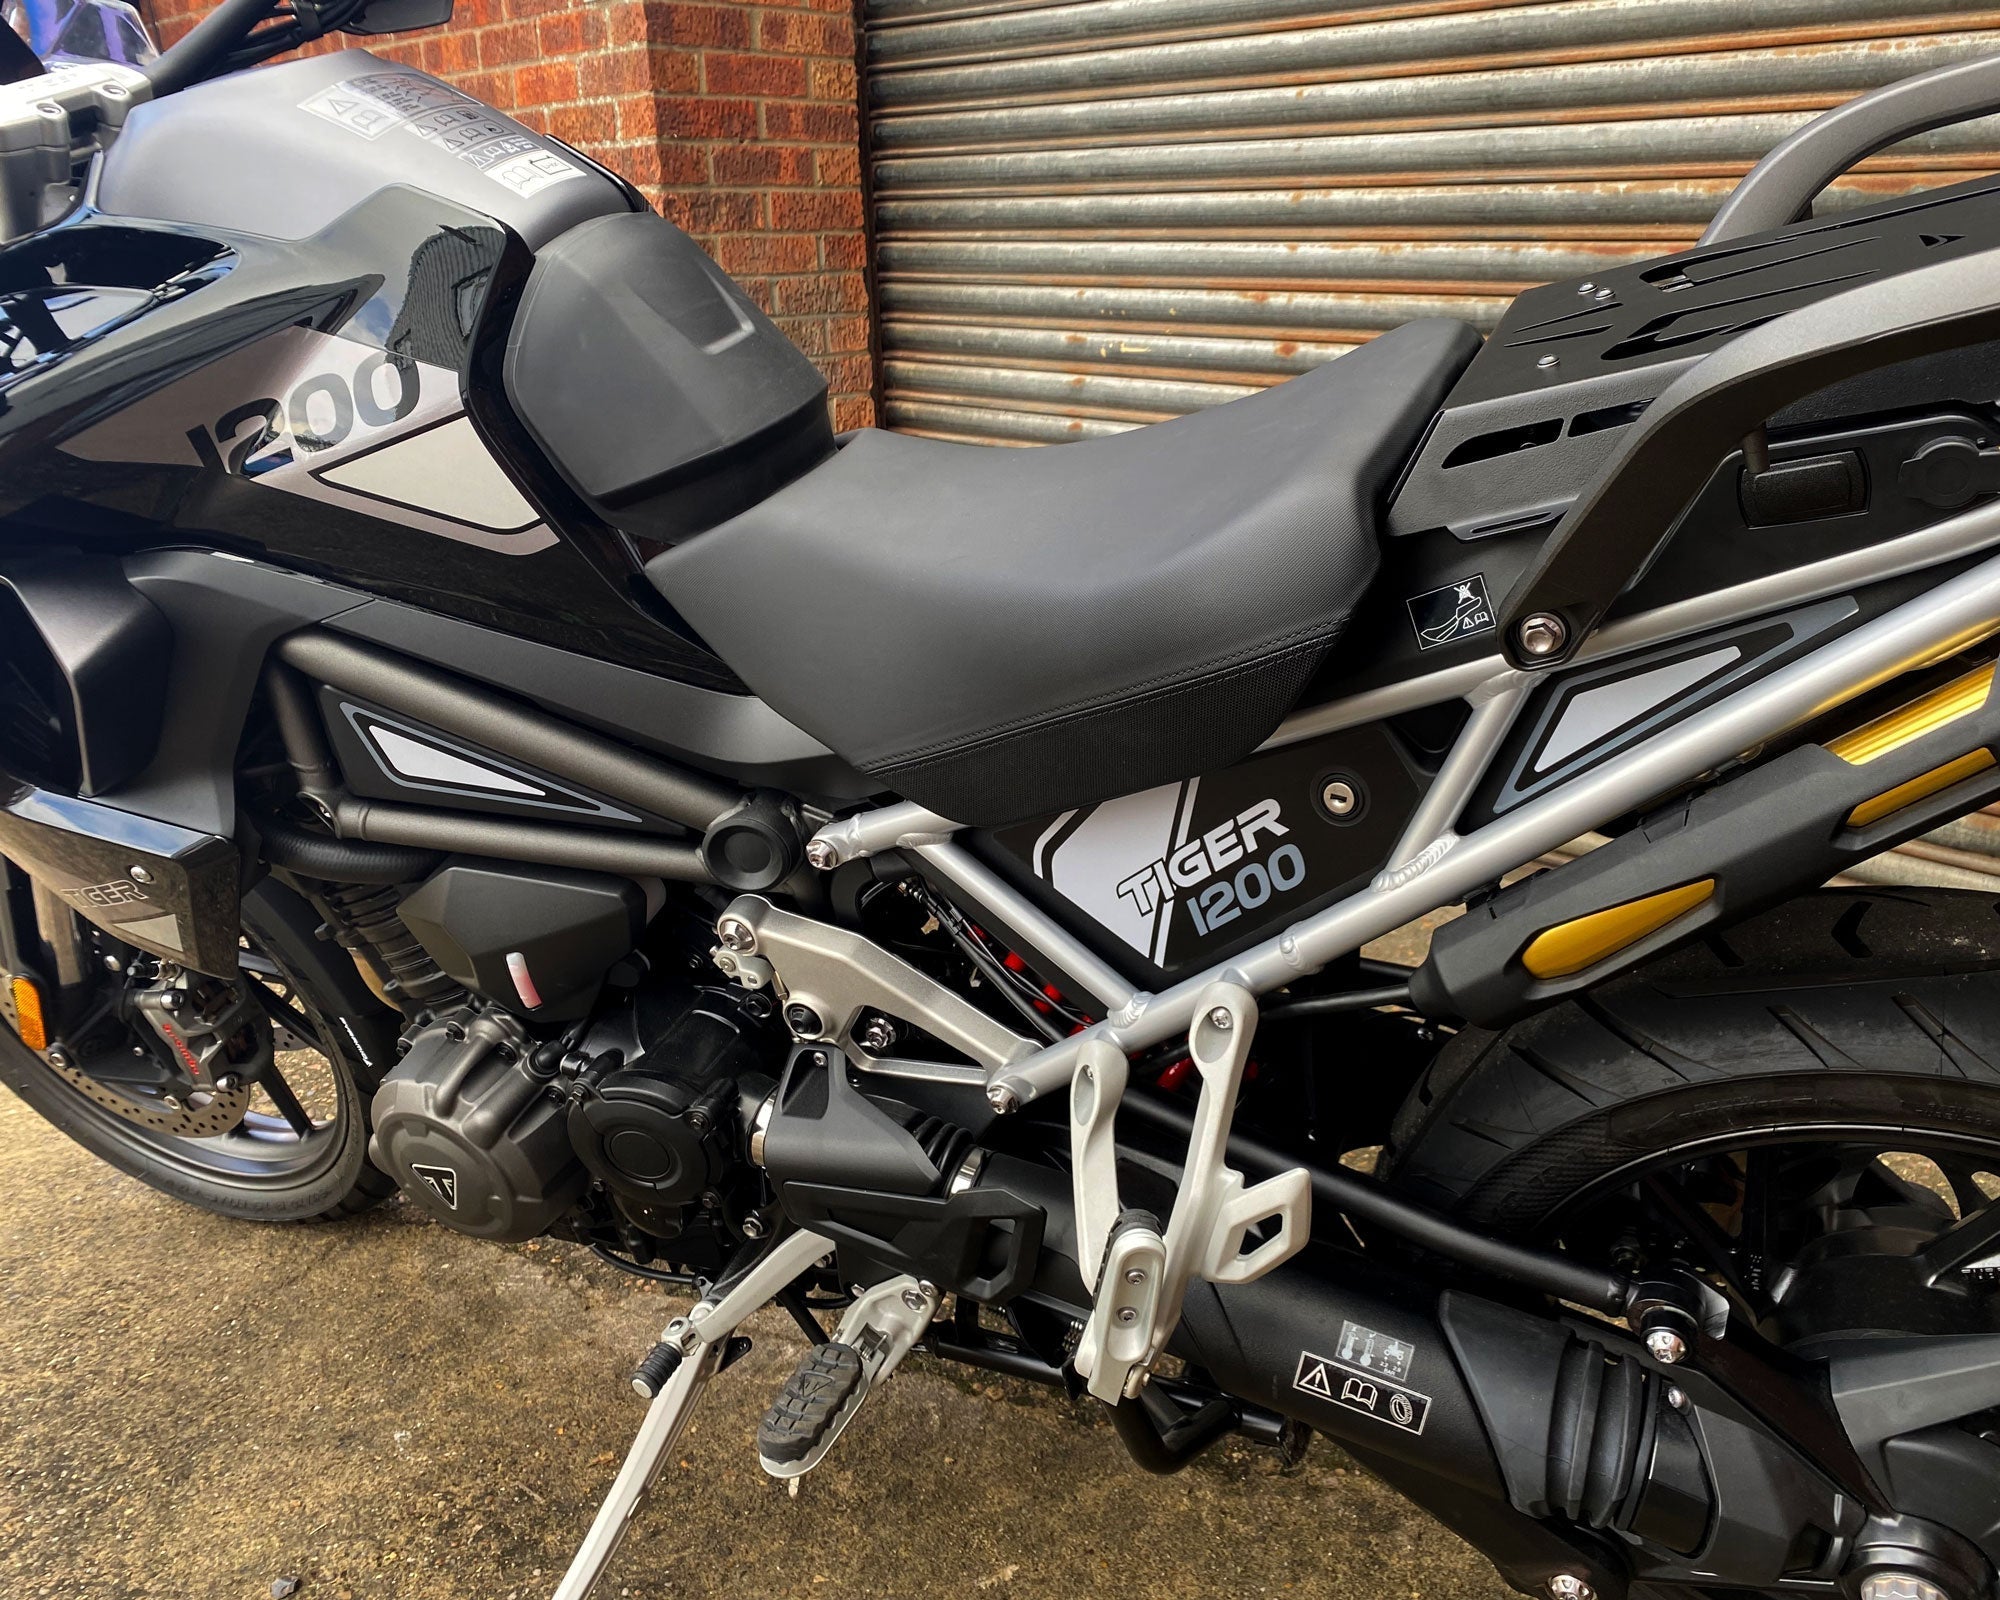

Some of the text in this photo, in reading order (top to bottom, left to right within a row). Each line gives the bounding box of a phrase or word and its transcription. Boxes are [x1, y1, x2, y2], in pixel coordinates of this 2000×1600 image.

[185, 350, 421, 478] 1200
[60, 880, 149, 908] TIGER
[1116, 798, 1290, 917] TIGER
[1186, 843, 1306, 937] 1200
[162, 1023, 200, 1075] brembo
